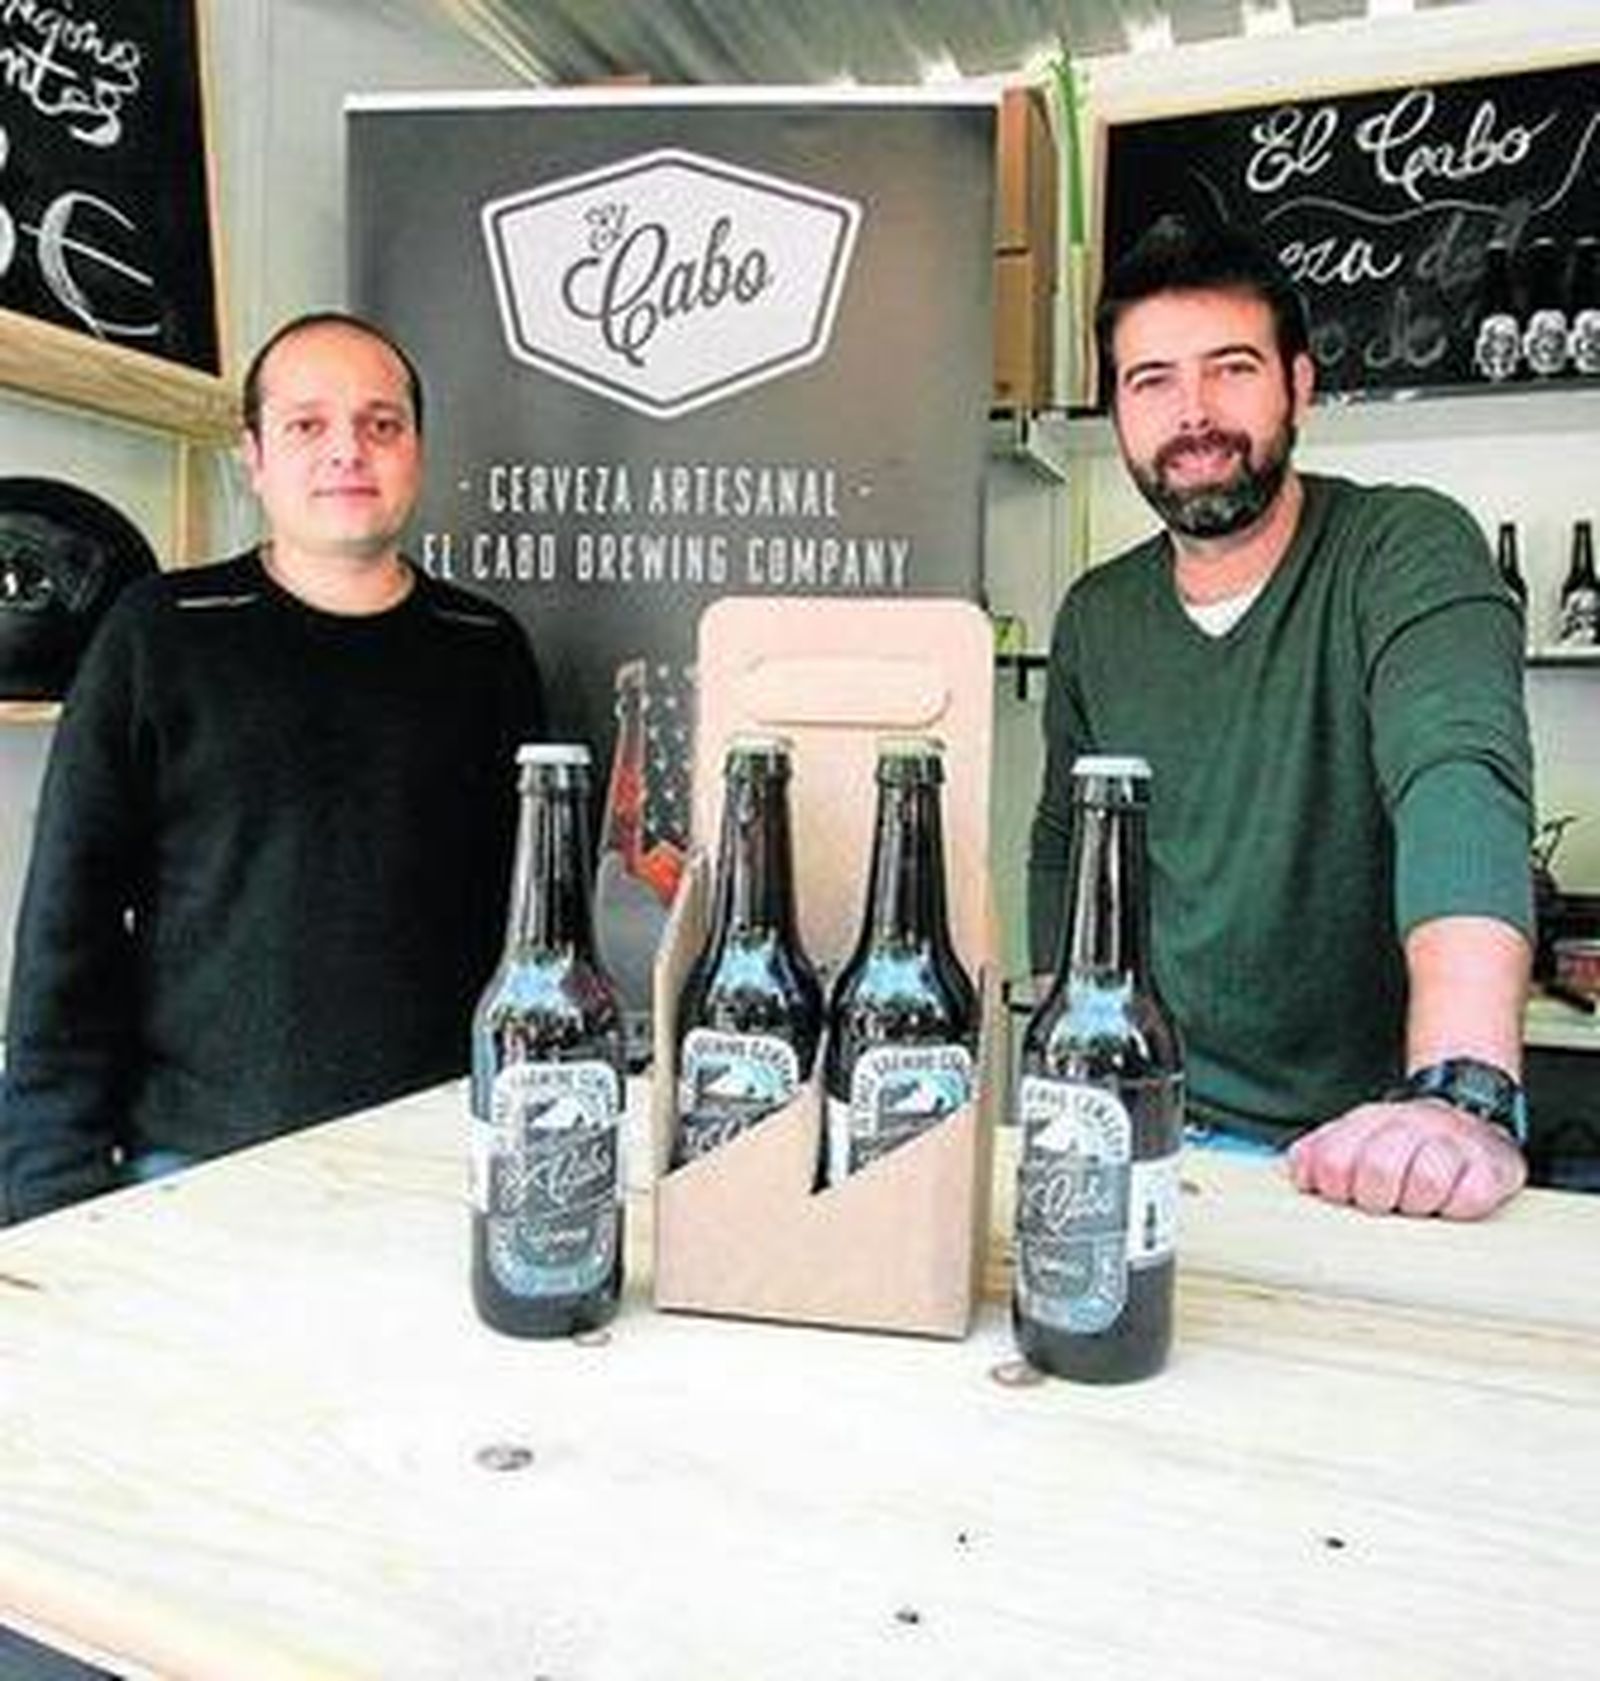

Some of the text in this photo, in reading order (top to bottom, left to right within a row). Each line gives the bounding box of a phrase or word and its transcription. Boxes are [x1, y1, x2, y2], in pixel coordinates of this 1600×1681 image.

[1246, 107, 1338, 192] El
[562, 216, 773, 367] Cabo
[489, 466, 839, 518] CERVEZA ARTESANAL
[422, 532, 910, 586] EL CABO BREWING COMPANY
